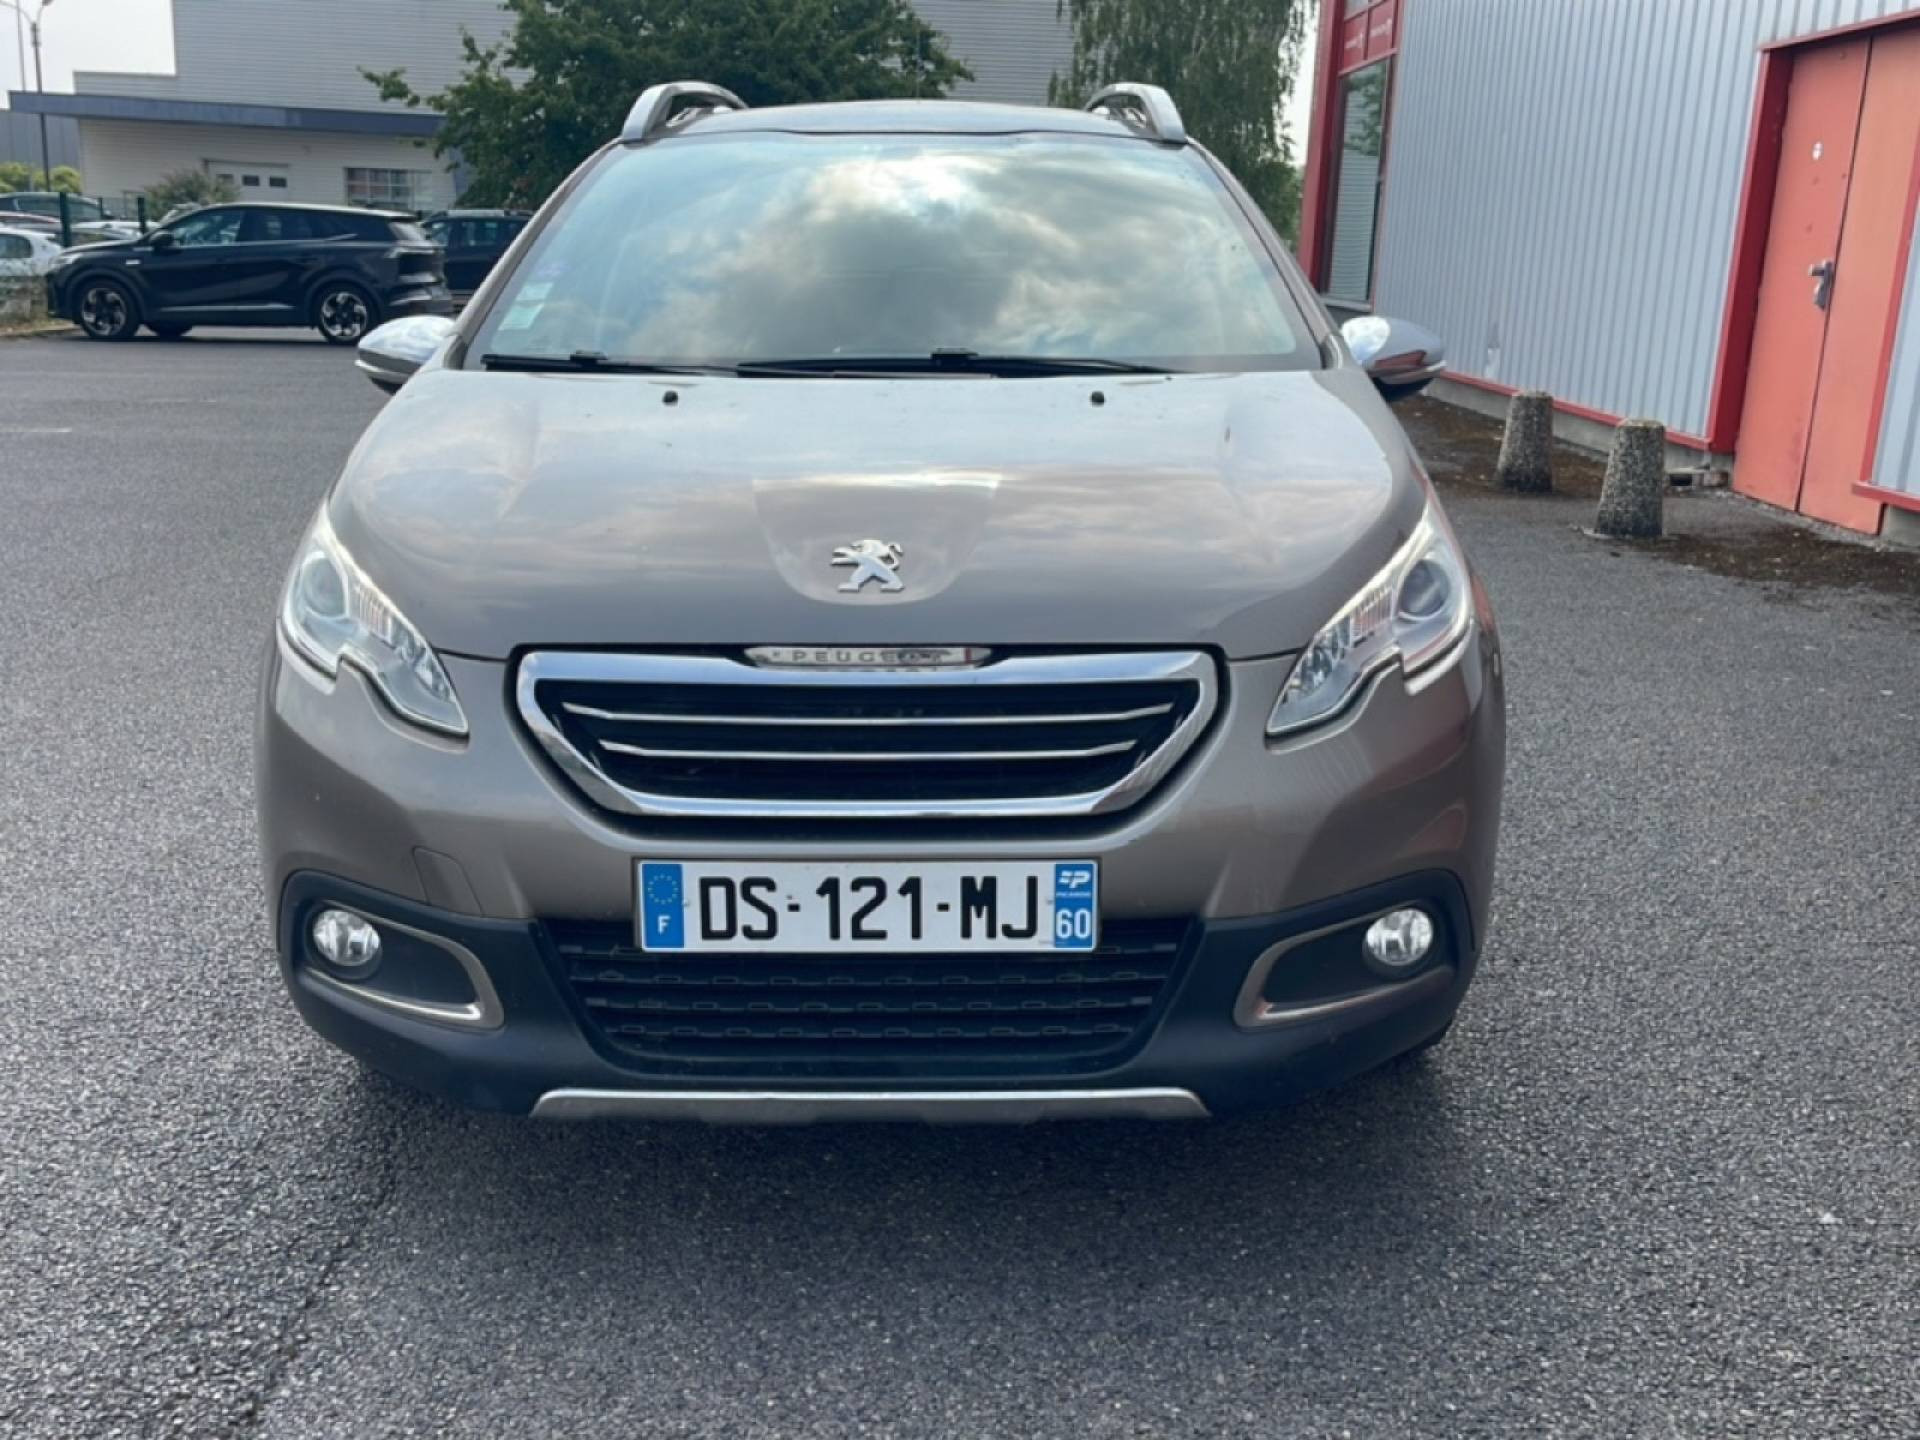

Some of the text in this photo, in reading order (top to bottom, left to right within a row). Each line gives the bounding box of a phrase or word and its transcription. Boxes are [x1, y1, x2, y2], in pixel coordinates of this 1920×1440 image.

[699, 876, 1038, 940] DS-121-MJ
[1056, 908, 1091, 938] 60
[656, 915, 671, 935] F
